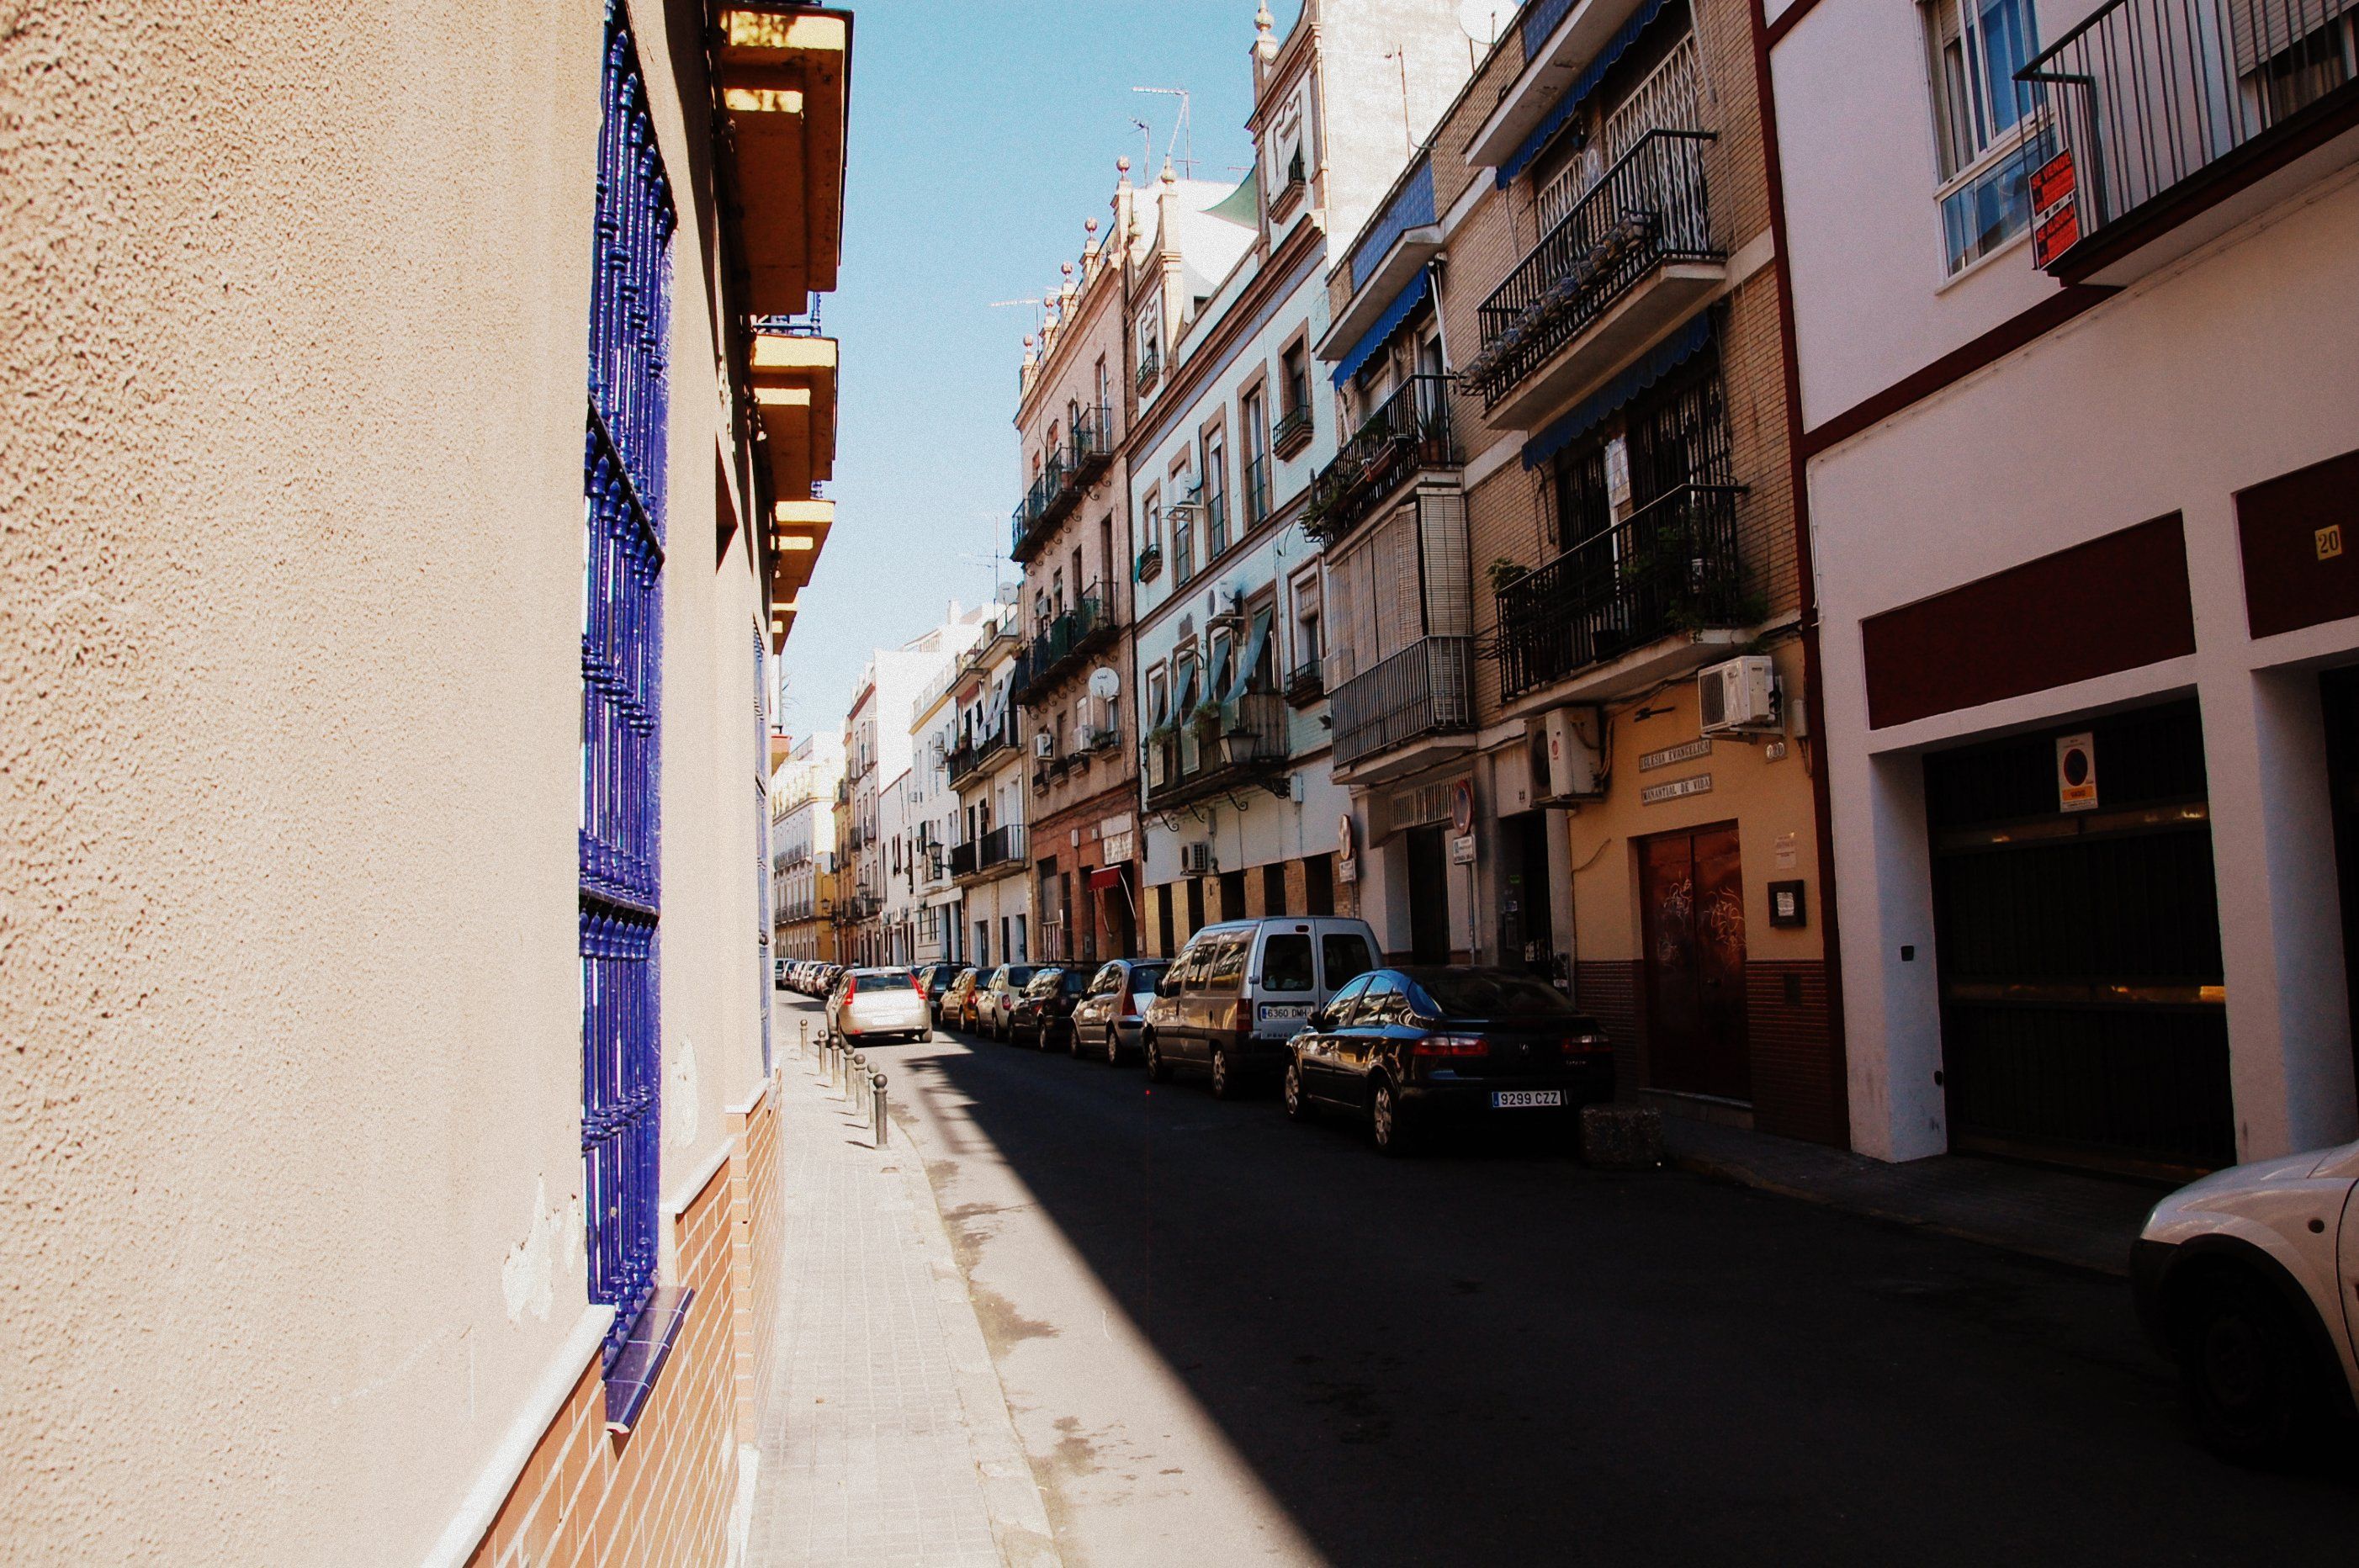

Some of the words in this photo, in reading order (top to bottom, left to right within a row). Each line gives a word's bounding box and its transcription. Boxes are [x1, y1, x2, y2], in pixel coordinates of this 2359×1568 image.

[2032, 172, 2042, 190] SE
[2043, 152, 2071, 180] VENDE
[2318, 530, 2339, 554] 20
[1640, 753, 1666, 769] IGLESIA
[1643, 785, 1678, 801] MANANTIAL
[1680, 781, 1689, 792] DE
[1693, 776, 1710, 790] VIDA
[1268, 1009, 1289, 1018] 6360
[1500, 1093, 1532, 1105] 9299
[1535, 1092, 1558, 1104] CZZ
